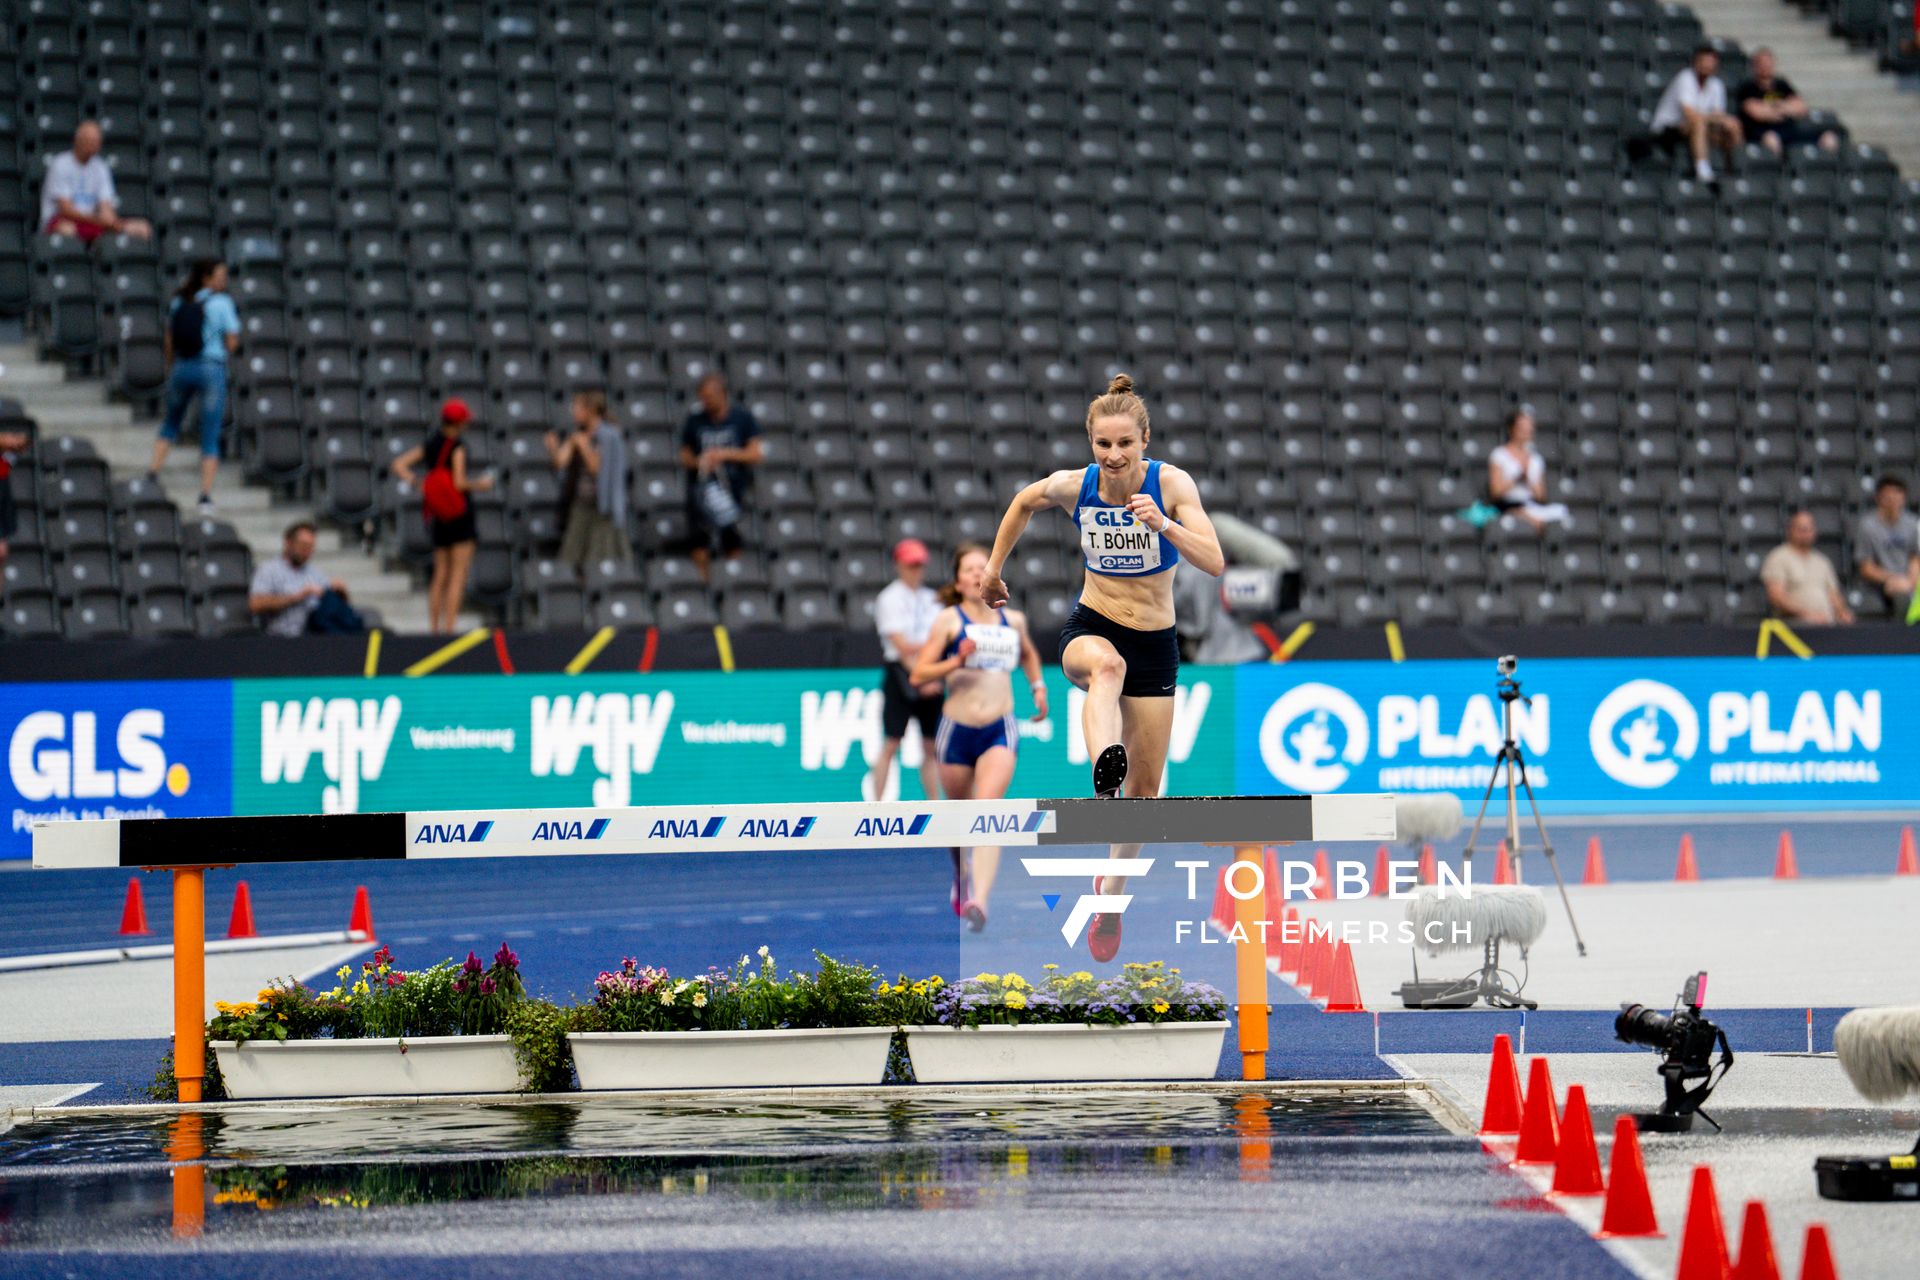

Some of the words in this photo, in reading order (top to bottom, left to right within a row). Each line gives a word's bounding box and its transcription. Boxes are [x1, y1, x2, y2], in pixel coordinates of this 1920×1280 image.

[1087, 531, 1100, 549] T.
[1103, 528, 1151, 550] BÖHM
[1117, 556, 1142, 565] PLAN
[1377, 693, 1550, 760] PLAN
[1708, 689, 1882, 753] PLAN
[409, 725, 516, 753] Versicherung
[1710, 760, 1881, 785] INTERNATIONAL
[415, 824, 466, 843] ANA
[532, 821, 583, 841] ANA
[648, 819, 699, 838] ANA
[738, 819, 790, 838] ANA
[854, 817, 905, 837] ANA
[969, 814, 1019, 834] ANA
